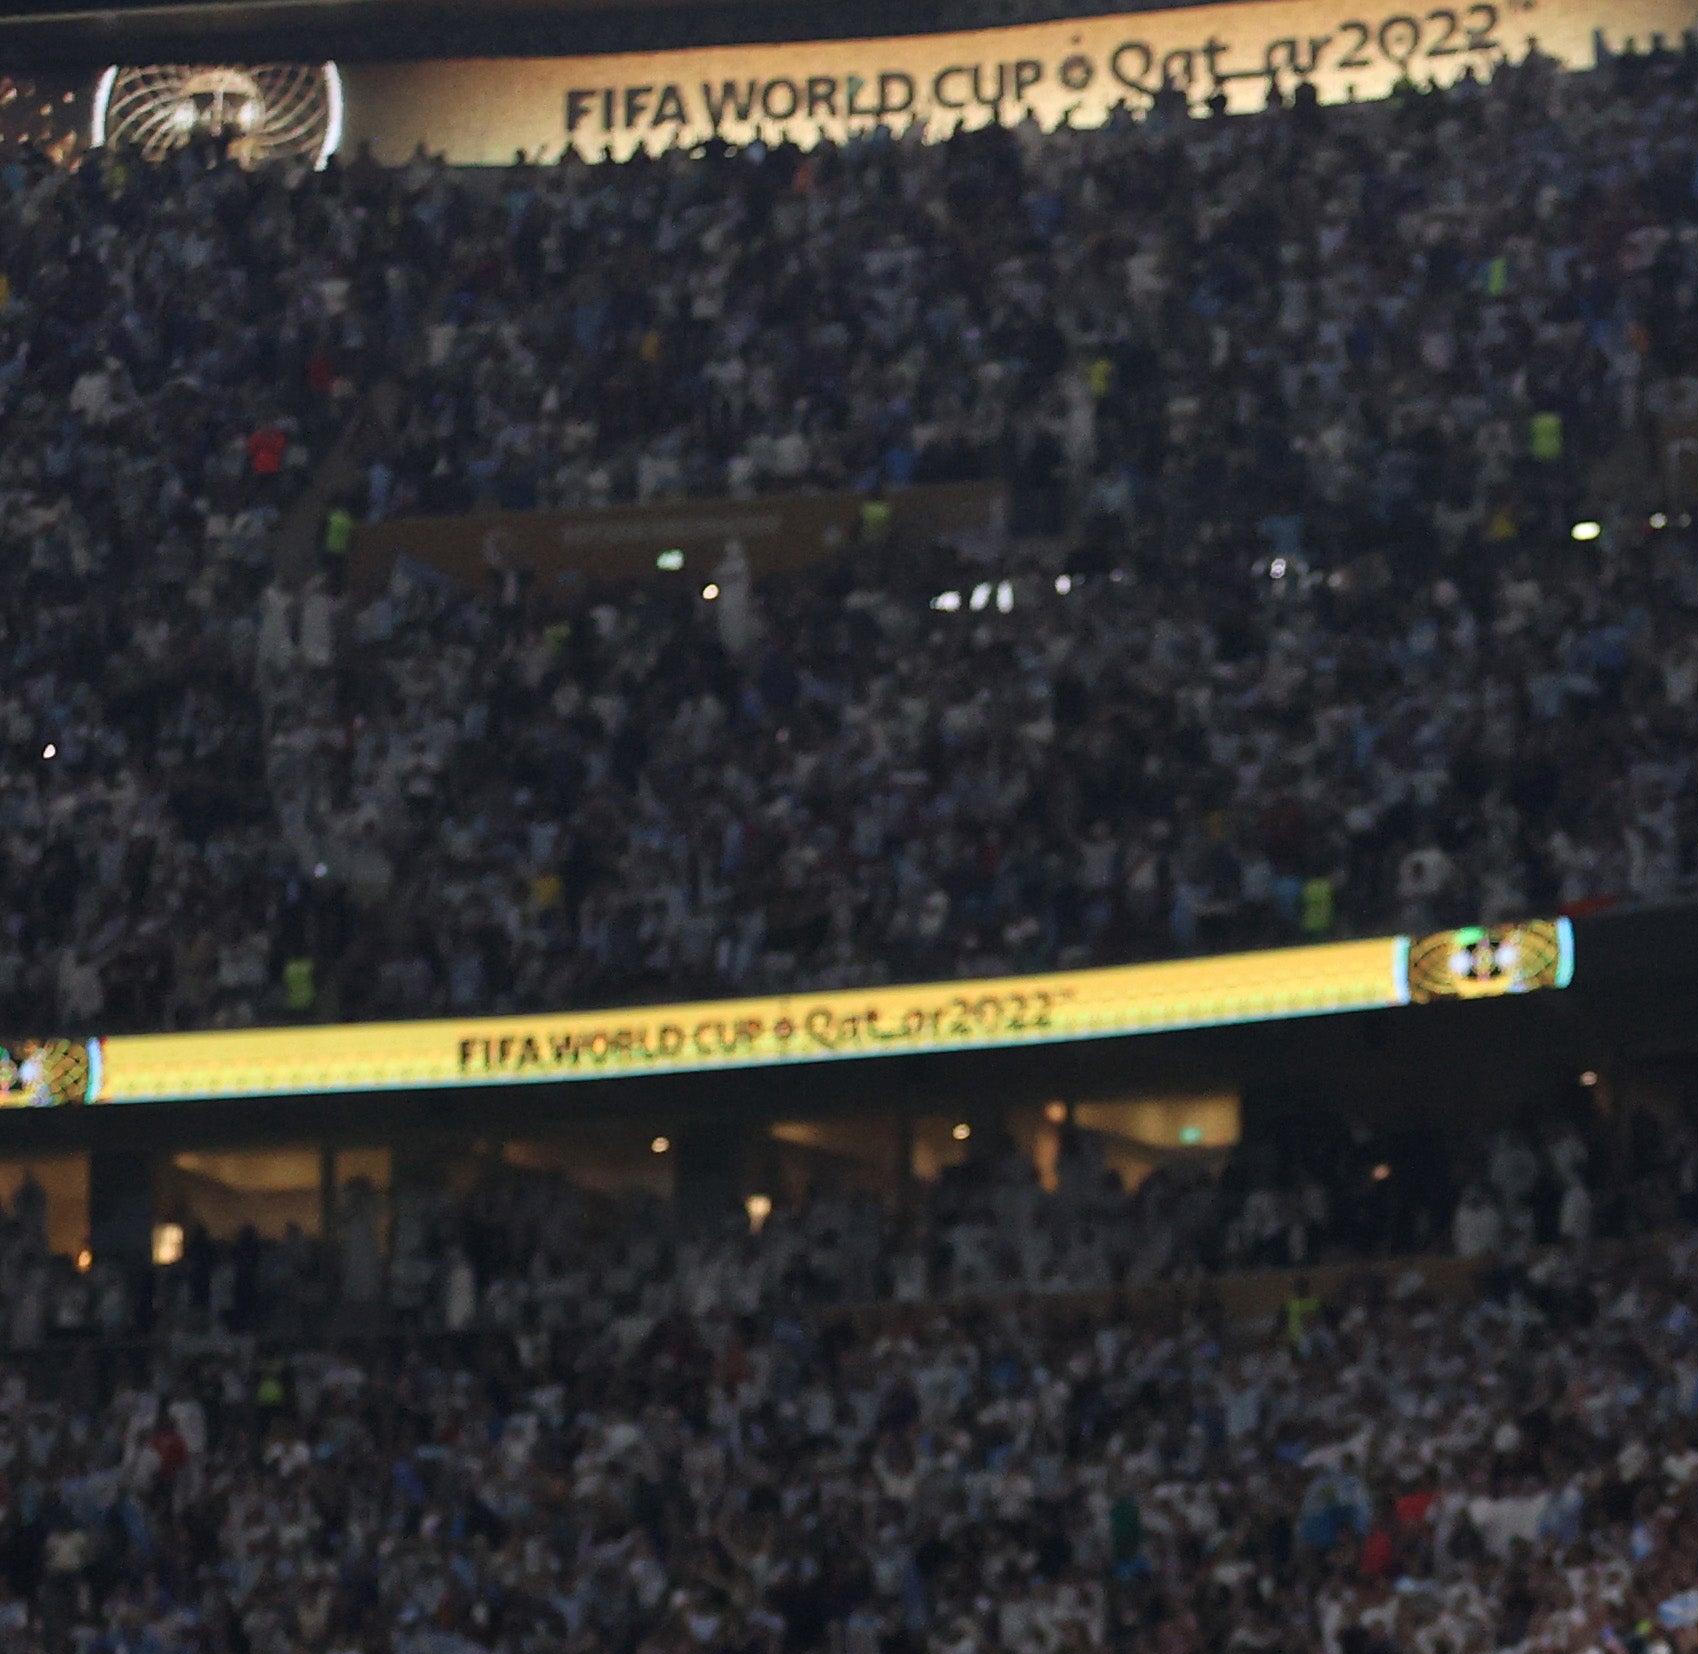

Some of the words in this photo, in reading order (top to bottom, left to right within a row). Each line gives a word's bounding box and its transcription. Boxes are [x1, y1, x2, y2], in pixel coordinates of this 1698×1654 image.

[565, 78, 686, 131] FIFA
[703, 71, 914, 122] WORLD
[932, 58, 1044, 108] CUP
[459, 1034, 541, 1073] FIFA
[551, 1025, 684, 1064] WORLD
[694, 1016, 763, 1054] CUP
